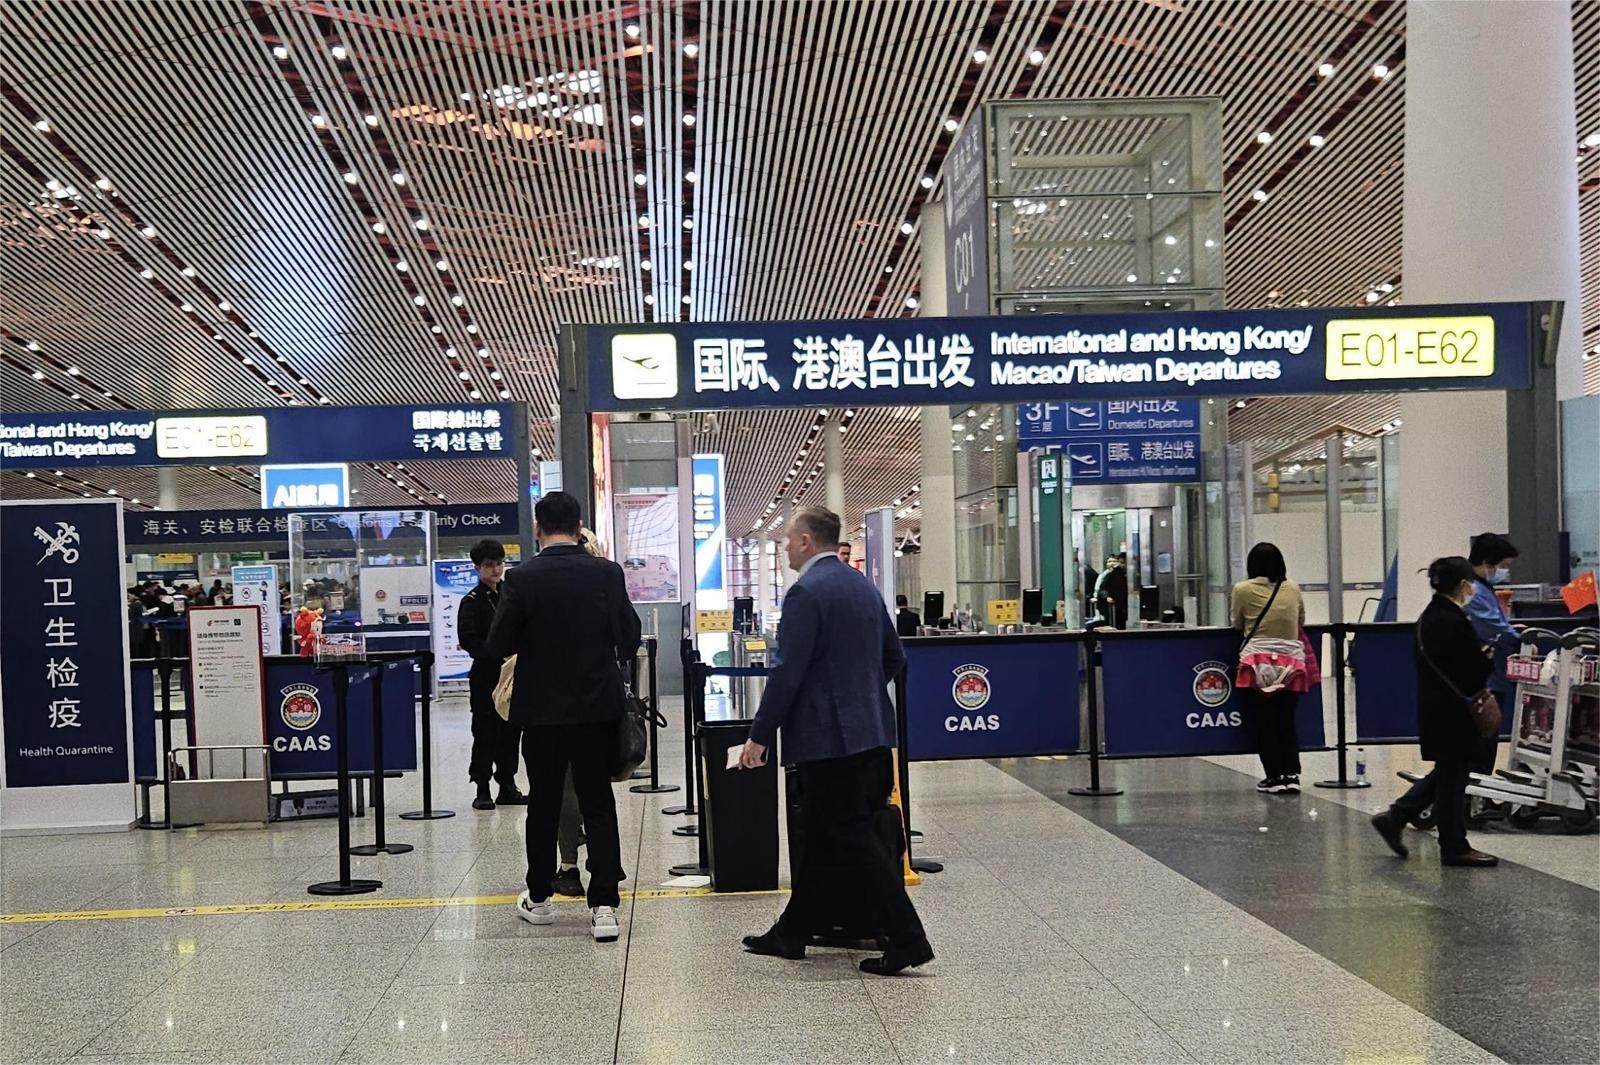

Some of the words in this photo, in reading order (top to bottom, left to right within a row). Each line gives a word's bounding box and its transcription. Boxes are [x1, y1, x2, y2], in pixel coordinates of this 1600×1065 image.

[990, 329, 1127, 355] International
[1129, 328, 1174, 352] and
[1178, 327, 1241, 355] Hong
[1243, 325, 1314, 354] Kong/
[1340, 330, 1479, 366] E01-E62
[692, 333, 976, 392] 国际、港澳台出发
[990, 359, 1151, 385] Macao/Taiwan
[1154, 357, 1282, 386] Departures
[36, 422, 65, 438] and
[67, 422, 109, 440] Hong
[109, 421, 155, 438] Kong/
[1030, 422, 1053, 433] 三层
[1107, 419, 1147, 431] Domestic
[1147, 418, 1194, 430] Departures
[165, 424, 254, 449] E-E62
[412, 431, 503, 453] 국제선출발
[54, 441, 136, 459] Departures
[1107, 440, 1195, 463] 国际、港澳台出发
[408, 514, 459, 529] Serity
[460, 513, 501, 526] Check
[43, 577, 82, 729] 卫生检疫
[944, 715, 1000, 732] CAAS
[1185, 711, 1242, 728] CAAS
[19, 747, 54, 757] Health
[55, 744, 114, 757] Quarantine
[273, 735, 331, 752] CAAS
